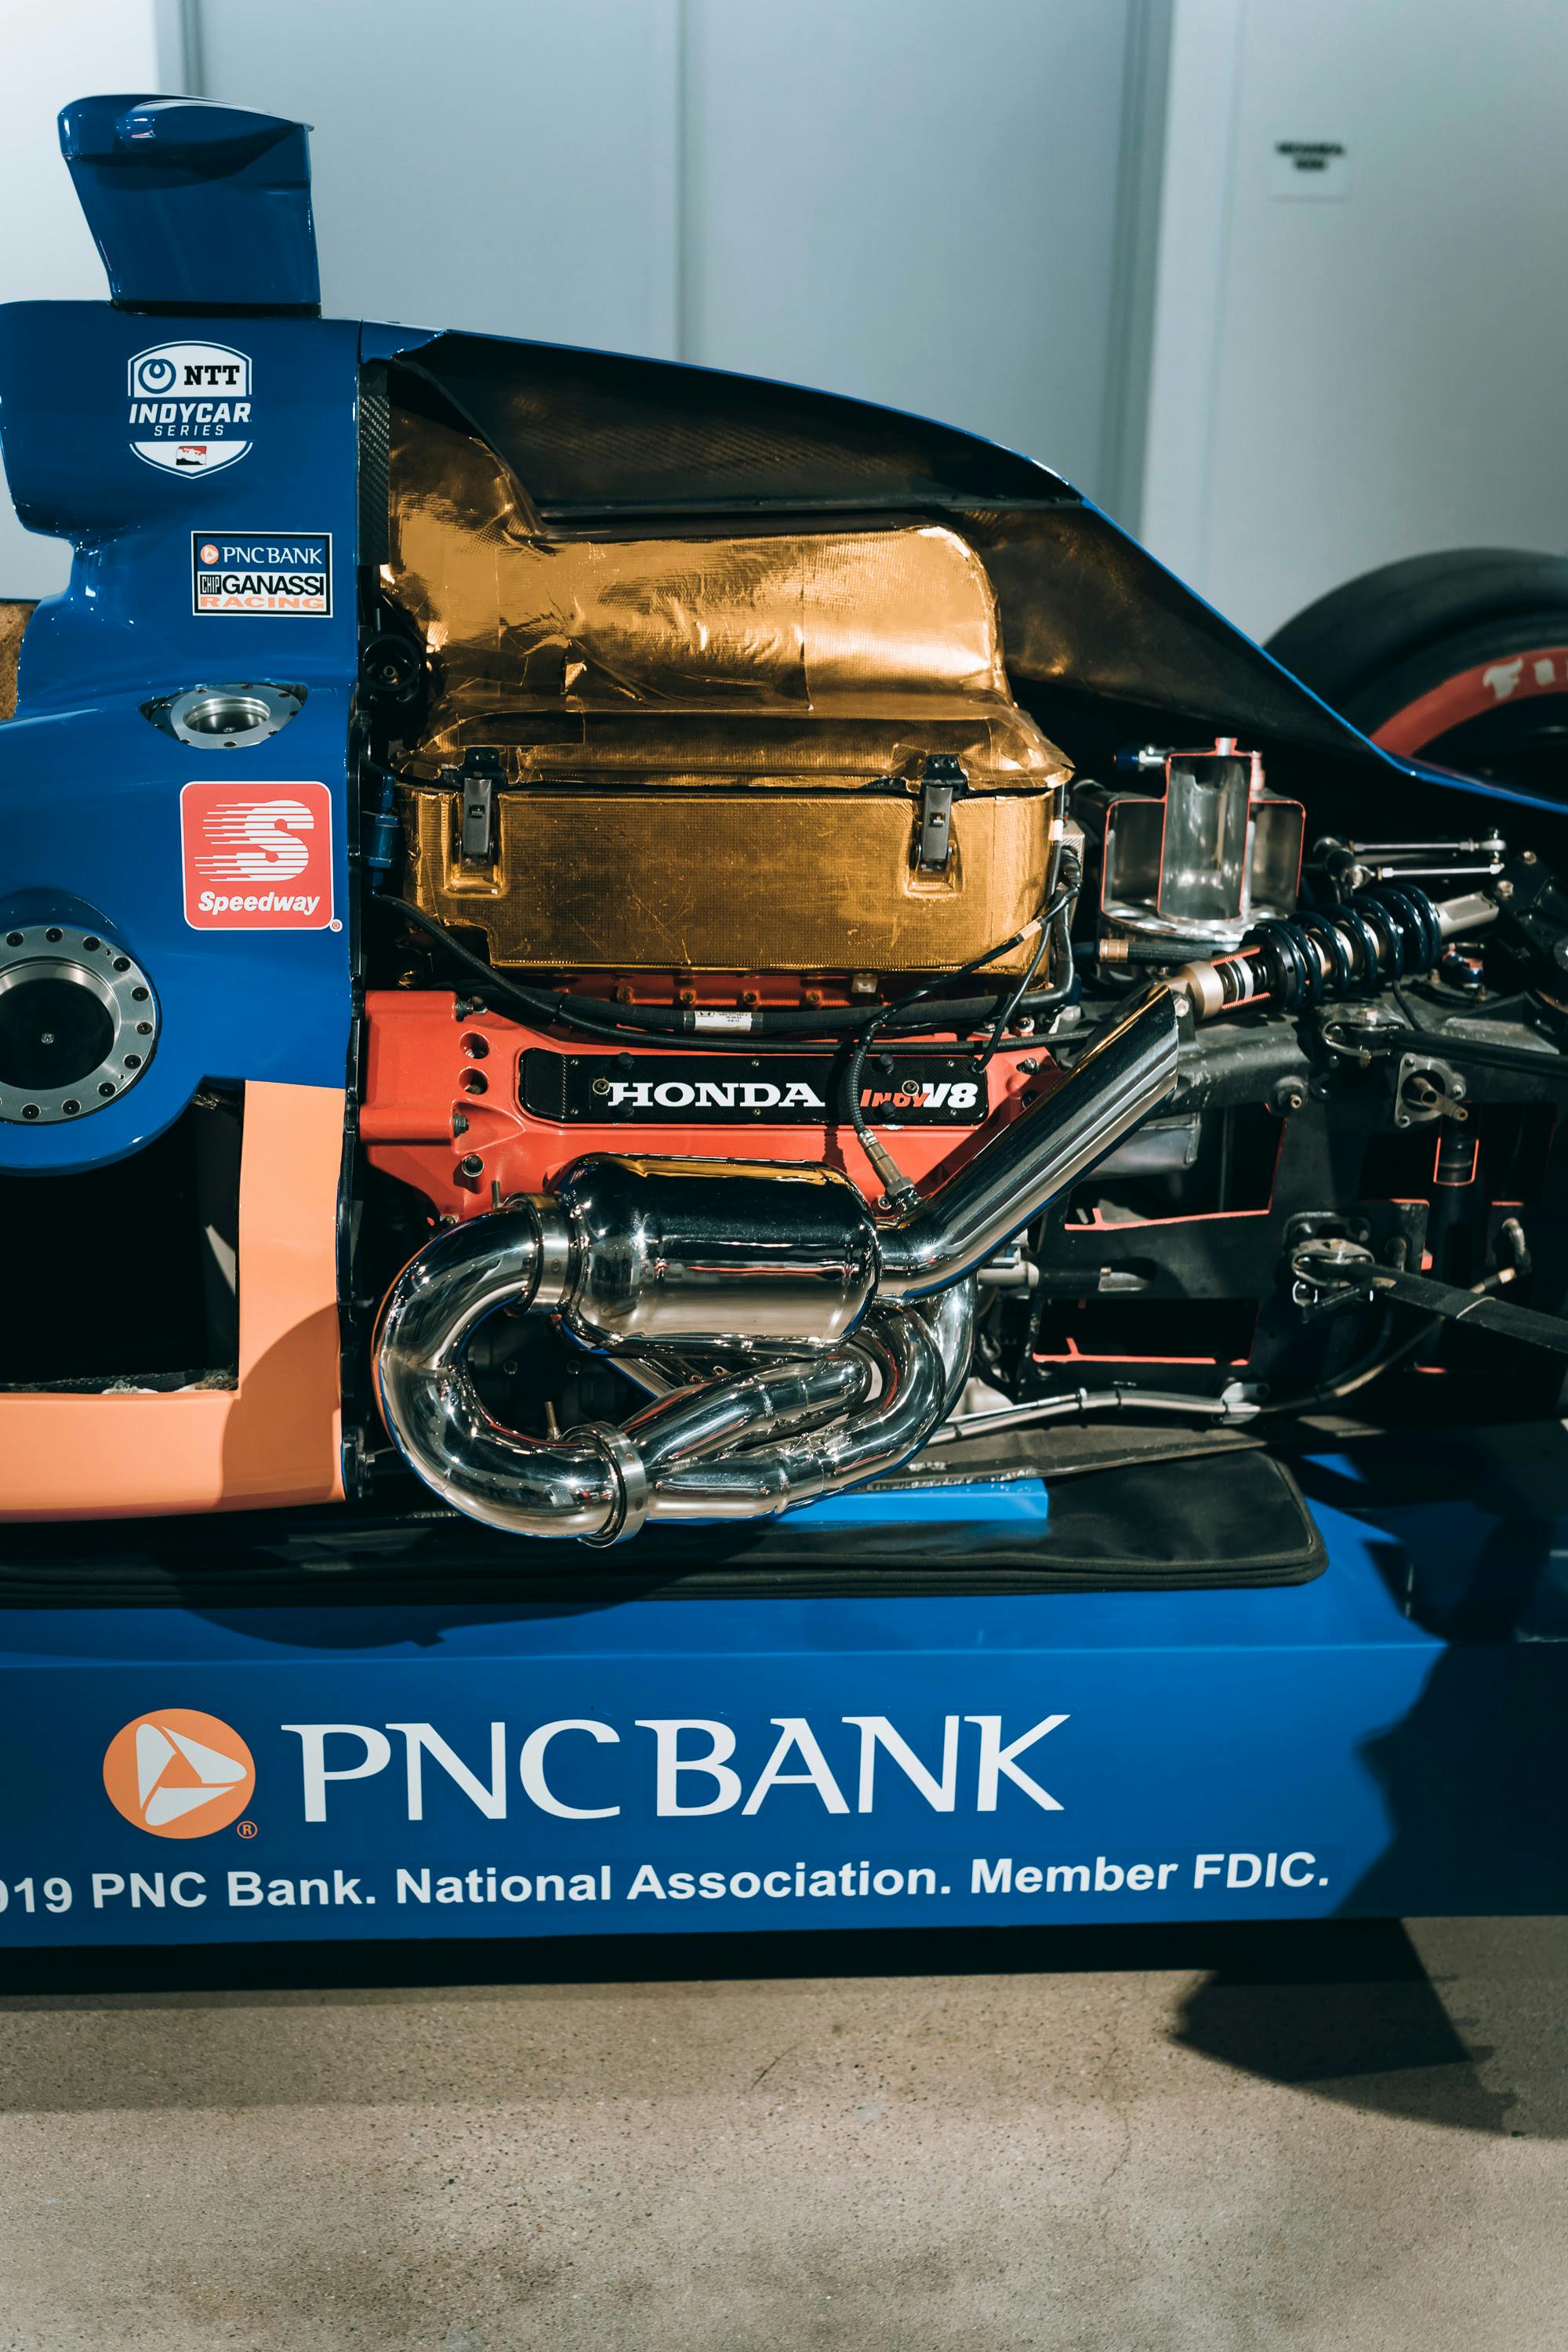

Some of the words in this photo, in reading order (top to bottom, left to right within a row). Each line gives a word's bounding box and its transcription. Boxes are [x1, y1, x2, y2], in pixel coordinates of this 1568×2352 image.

[183, 365, 240, 385] NTT
[129, 402, 252, 424] INDYCAR
[154, 424, 224, 436] SERIES
[200, 575, 221, 594] CHIP
[223, 575, 324, 596] GANASSI
[200, 596, 324, 609] RACING
[198, 891, 320, 915] Speedway
[608, 1081, 826, 1107] HONDA
[0, 1878, 73, 1913] 19
[92, 1871, 207, 1908] PNC
[227, 1870, 376, 1906] Bank.
[396, 1865, 612, 1904] National
[626, 1861, 950, 1900] Association.
[971, 1857, 1178, 1893] Member
[1193, 1851, 1329, 1889] FDIC.
